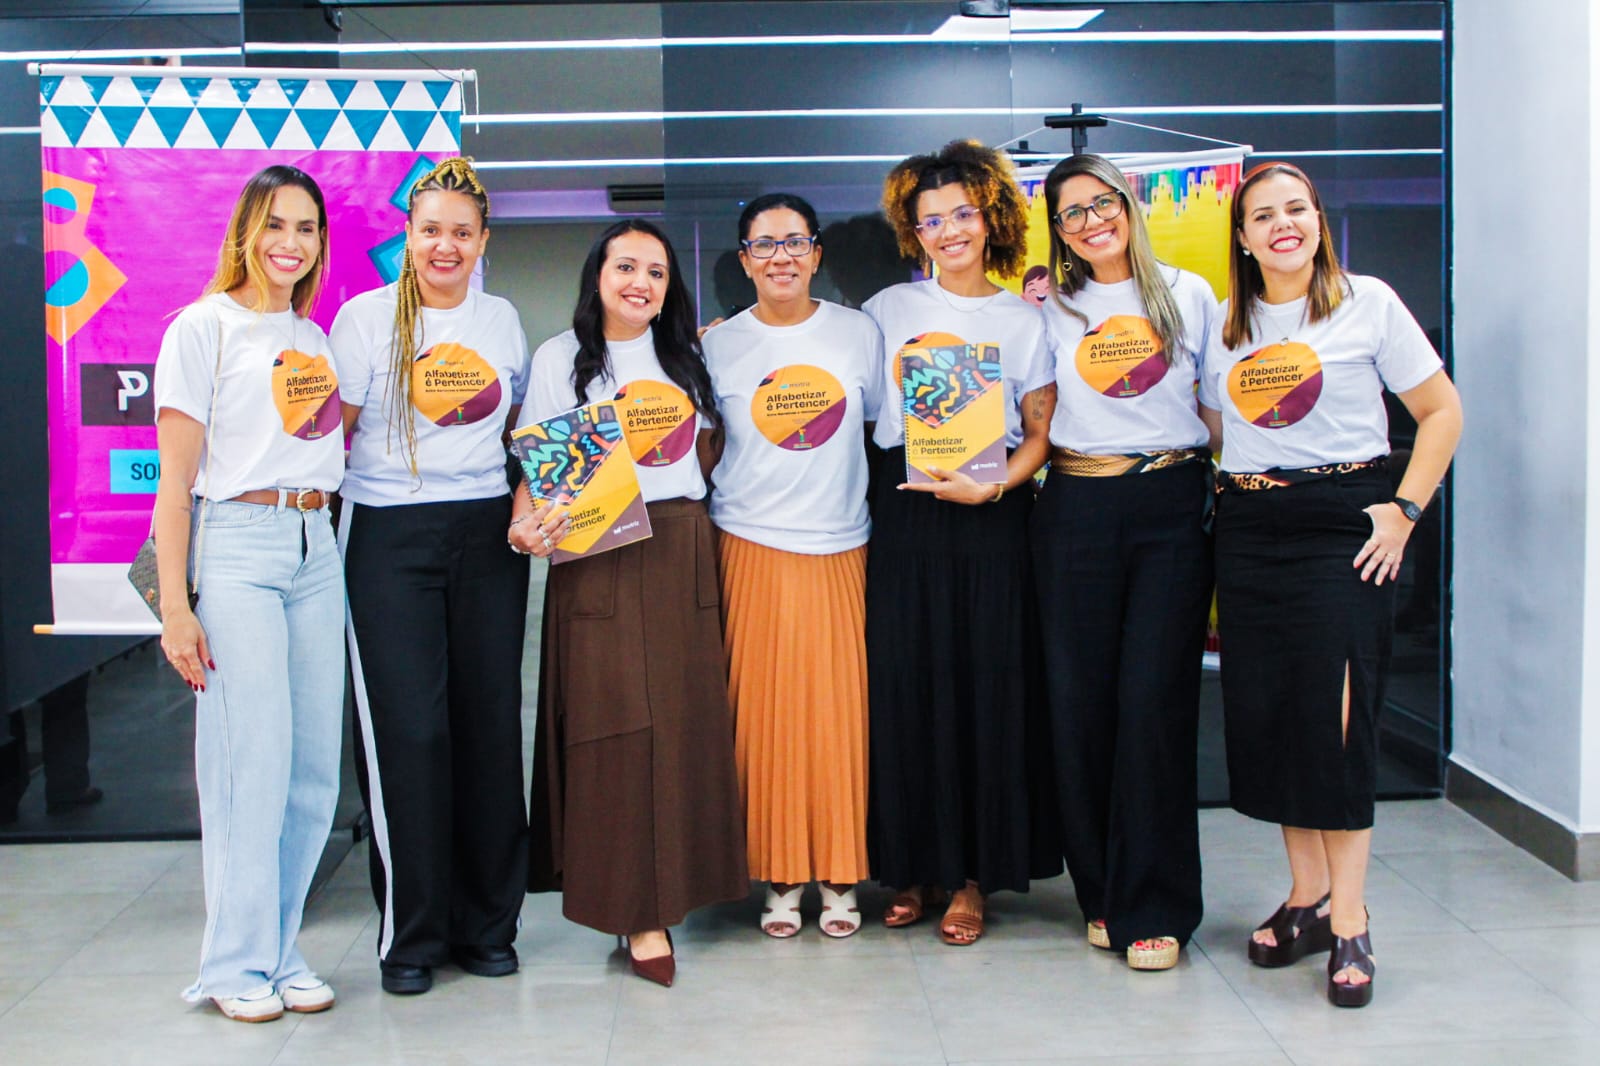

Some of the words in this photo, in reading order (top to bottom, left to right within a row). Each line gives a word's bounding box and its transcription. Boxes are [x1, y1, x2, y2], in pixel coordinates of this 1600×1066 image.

[1090, 339, 1150, 351] Alfabetizar
[1090, 350, 1097, 359] é
[1099, 346, 1154, 358] Pertencer
[424, 369, 481, 379] Alfabetizar
[1240, 364, 1300, 378] Alfabetizar
[286, 375, 327, 388] Alfabetizar
[425, 377, 432, 387] é
[434, 377, 486, 387] Pertencer
[1240, 377, 1247, 387] é
[1249, 373, 1304, 387] Pertencer
[287, 388, 293, 398] é
[294, 383, 332, 396] Pertencer
[766, 390, 827, 403] Alfabetizar
[626, 405, 679, 418] Alfabetizar
[766, 402, 774, 411] é
[775, 399, 831, 411] Pertencer
[628, 417, 635, 428] é
[636, 414, 683, 426] Pertencer
[911, 437, 964, 447] Alfabetizar
[920, 445, 967, 455] Pertencer
